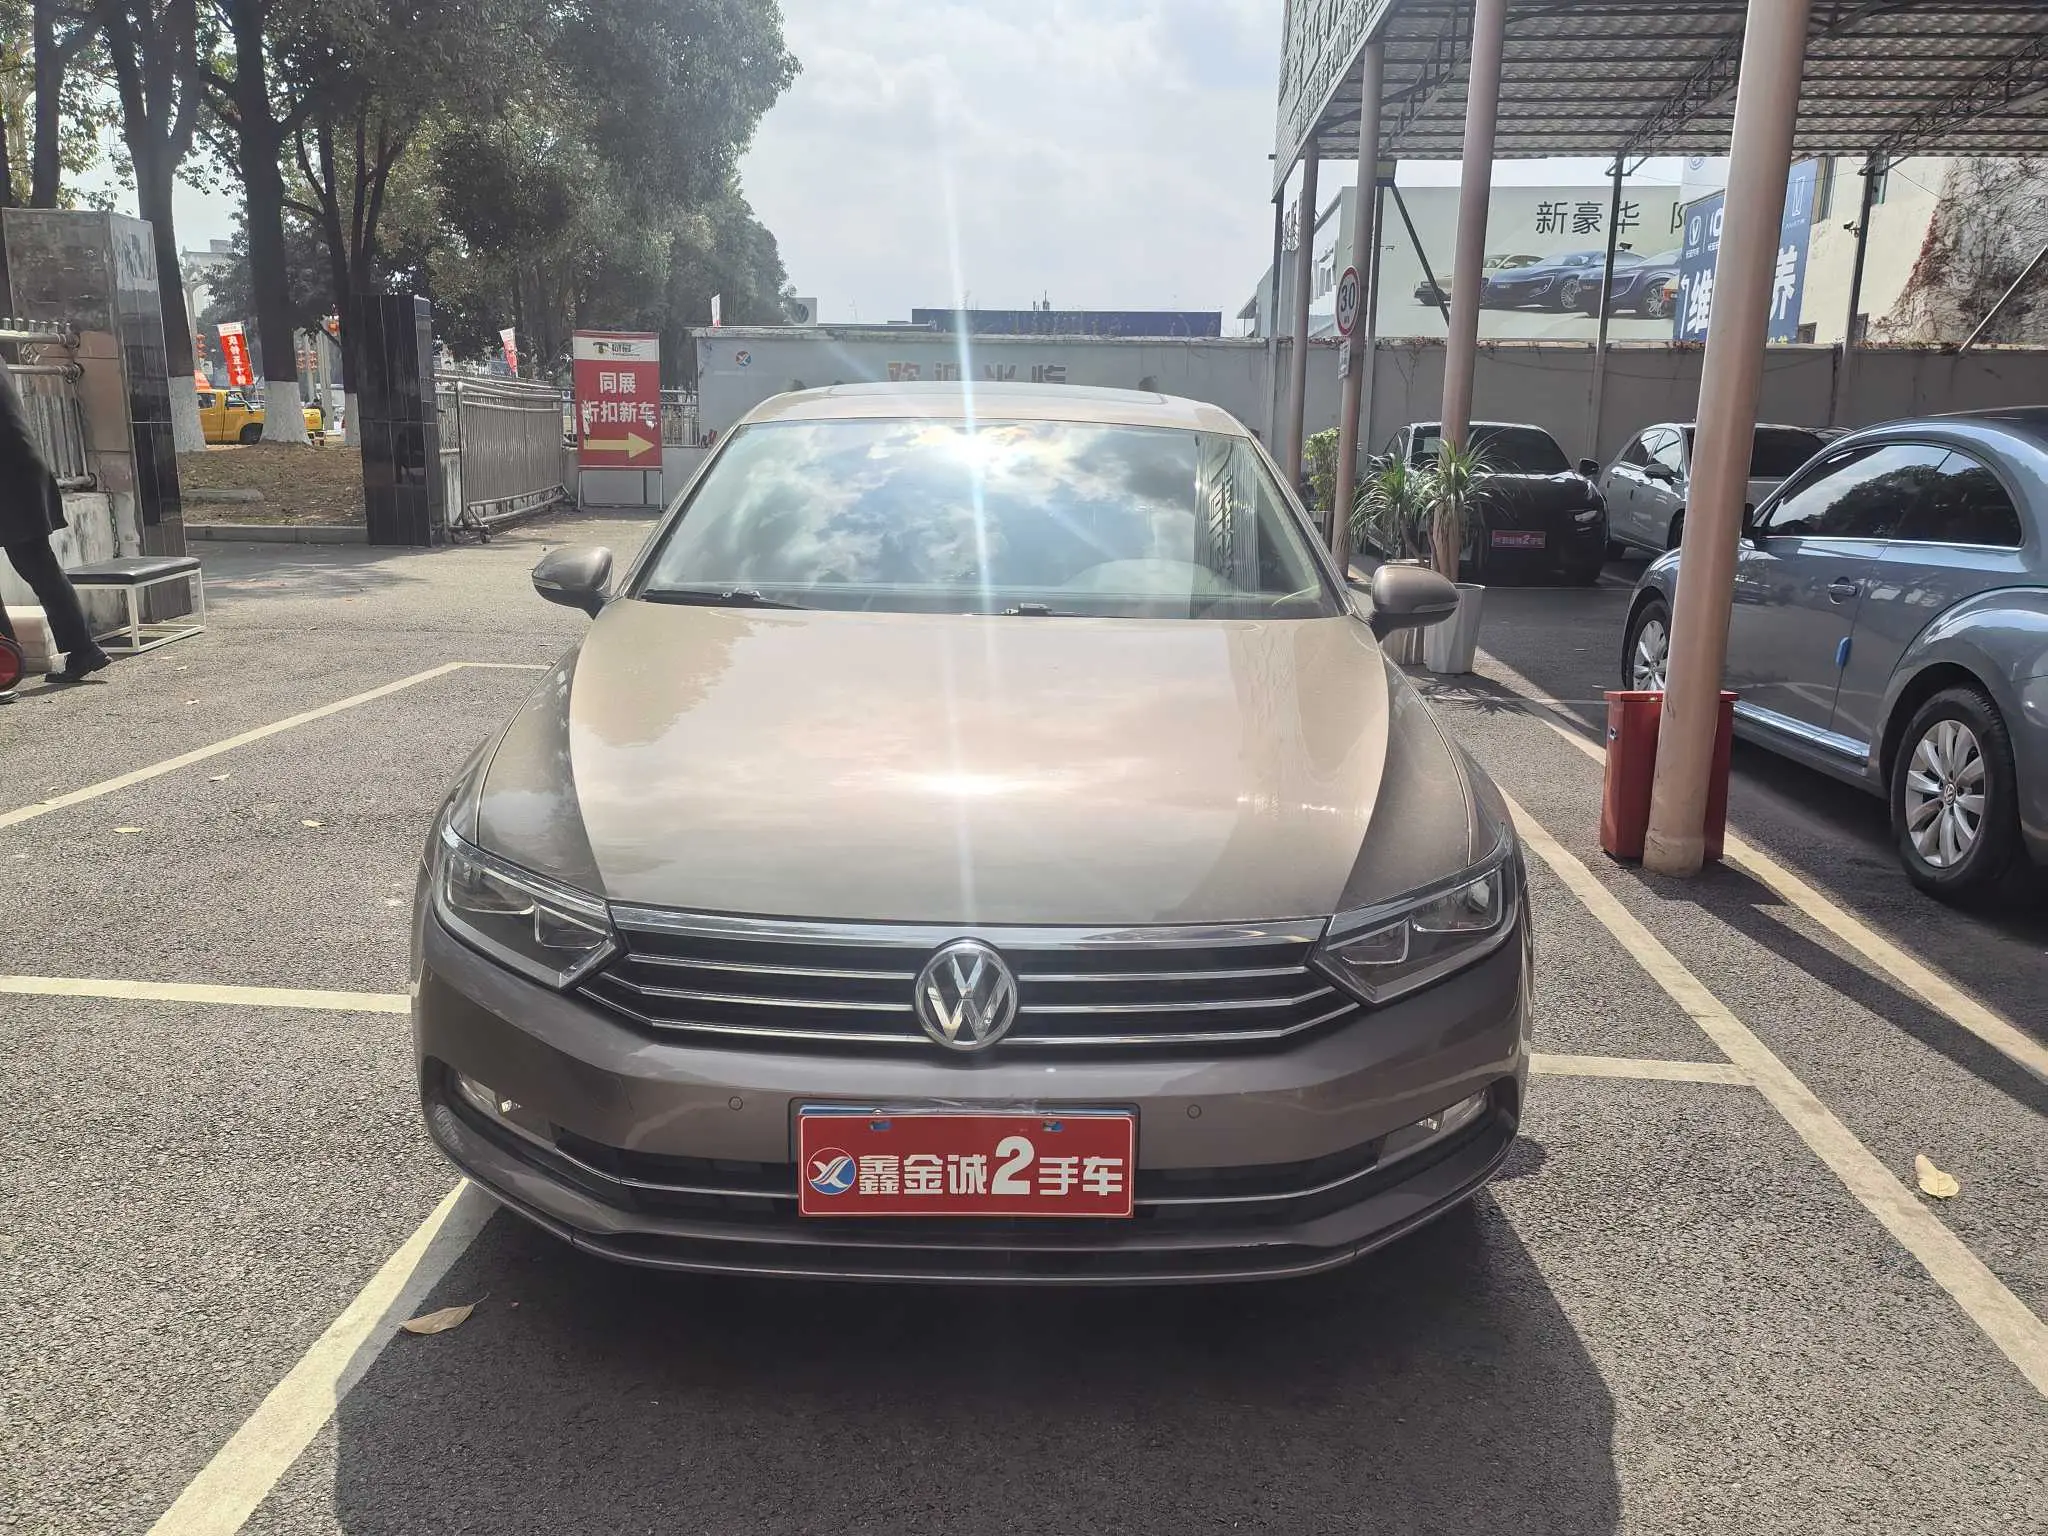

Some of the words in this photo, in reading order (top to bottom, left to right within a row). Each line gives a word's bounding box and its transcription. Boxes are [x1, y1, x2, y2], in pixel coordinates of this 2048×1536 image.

[1535, 200, 1641, 235] 新豪华
[1340, 282, 1356, 313] 30
[599, 371, 637, 394] 同展
[580, 400, 658, 424] 折扣新车
[858, 1135, 1123, 1197] 鑫金诚2手车
